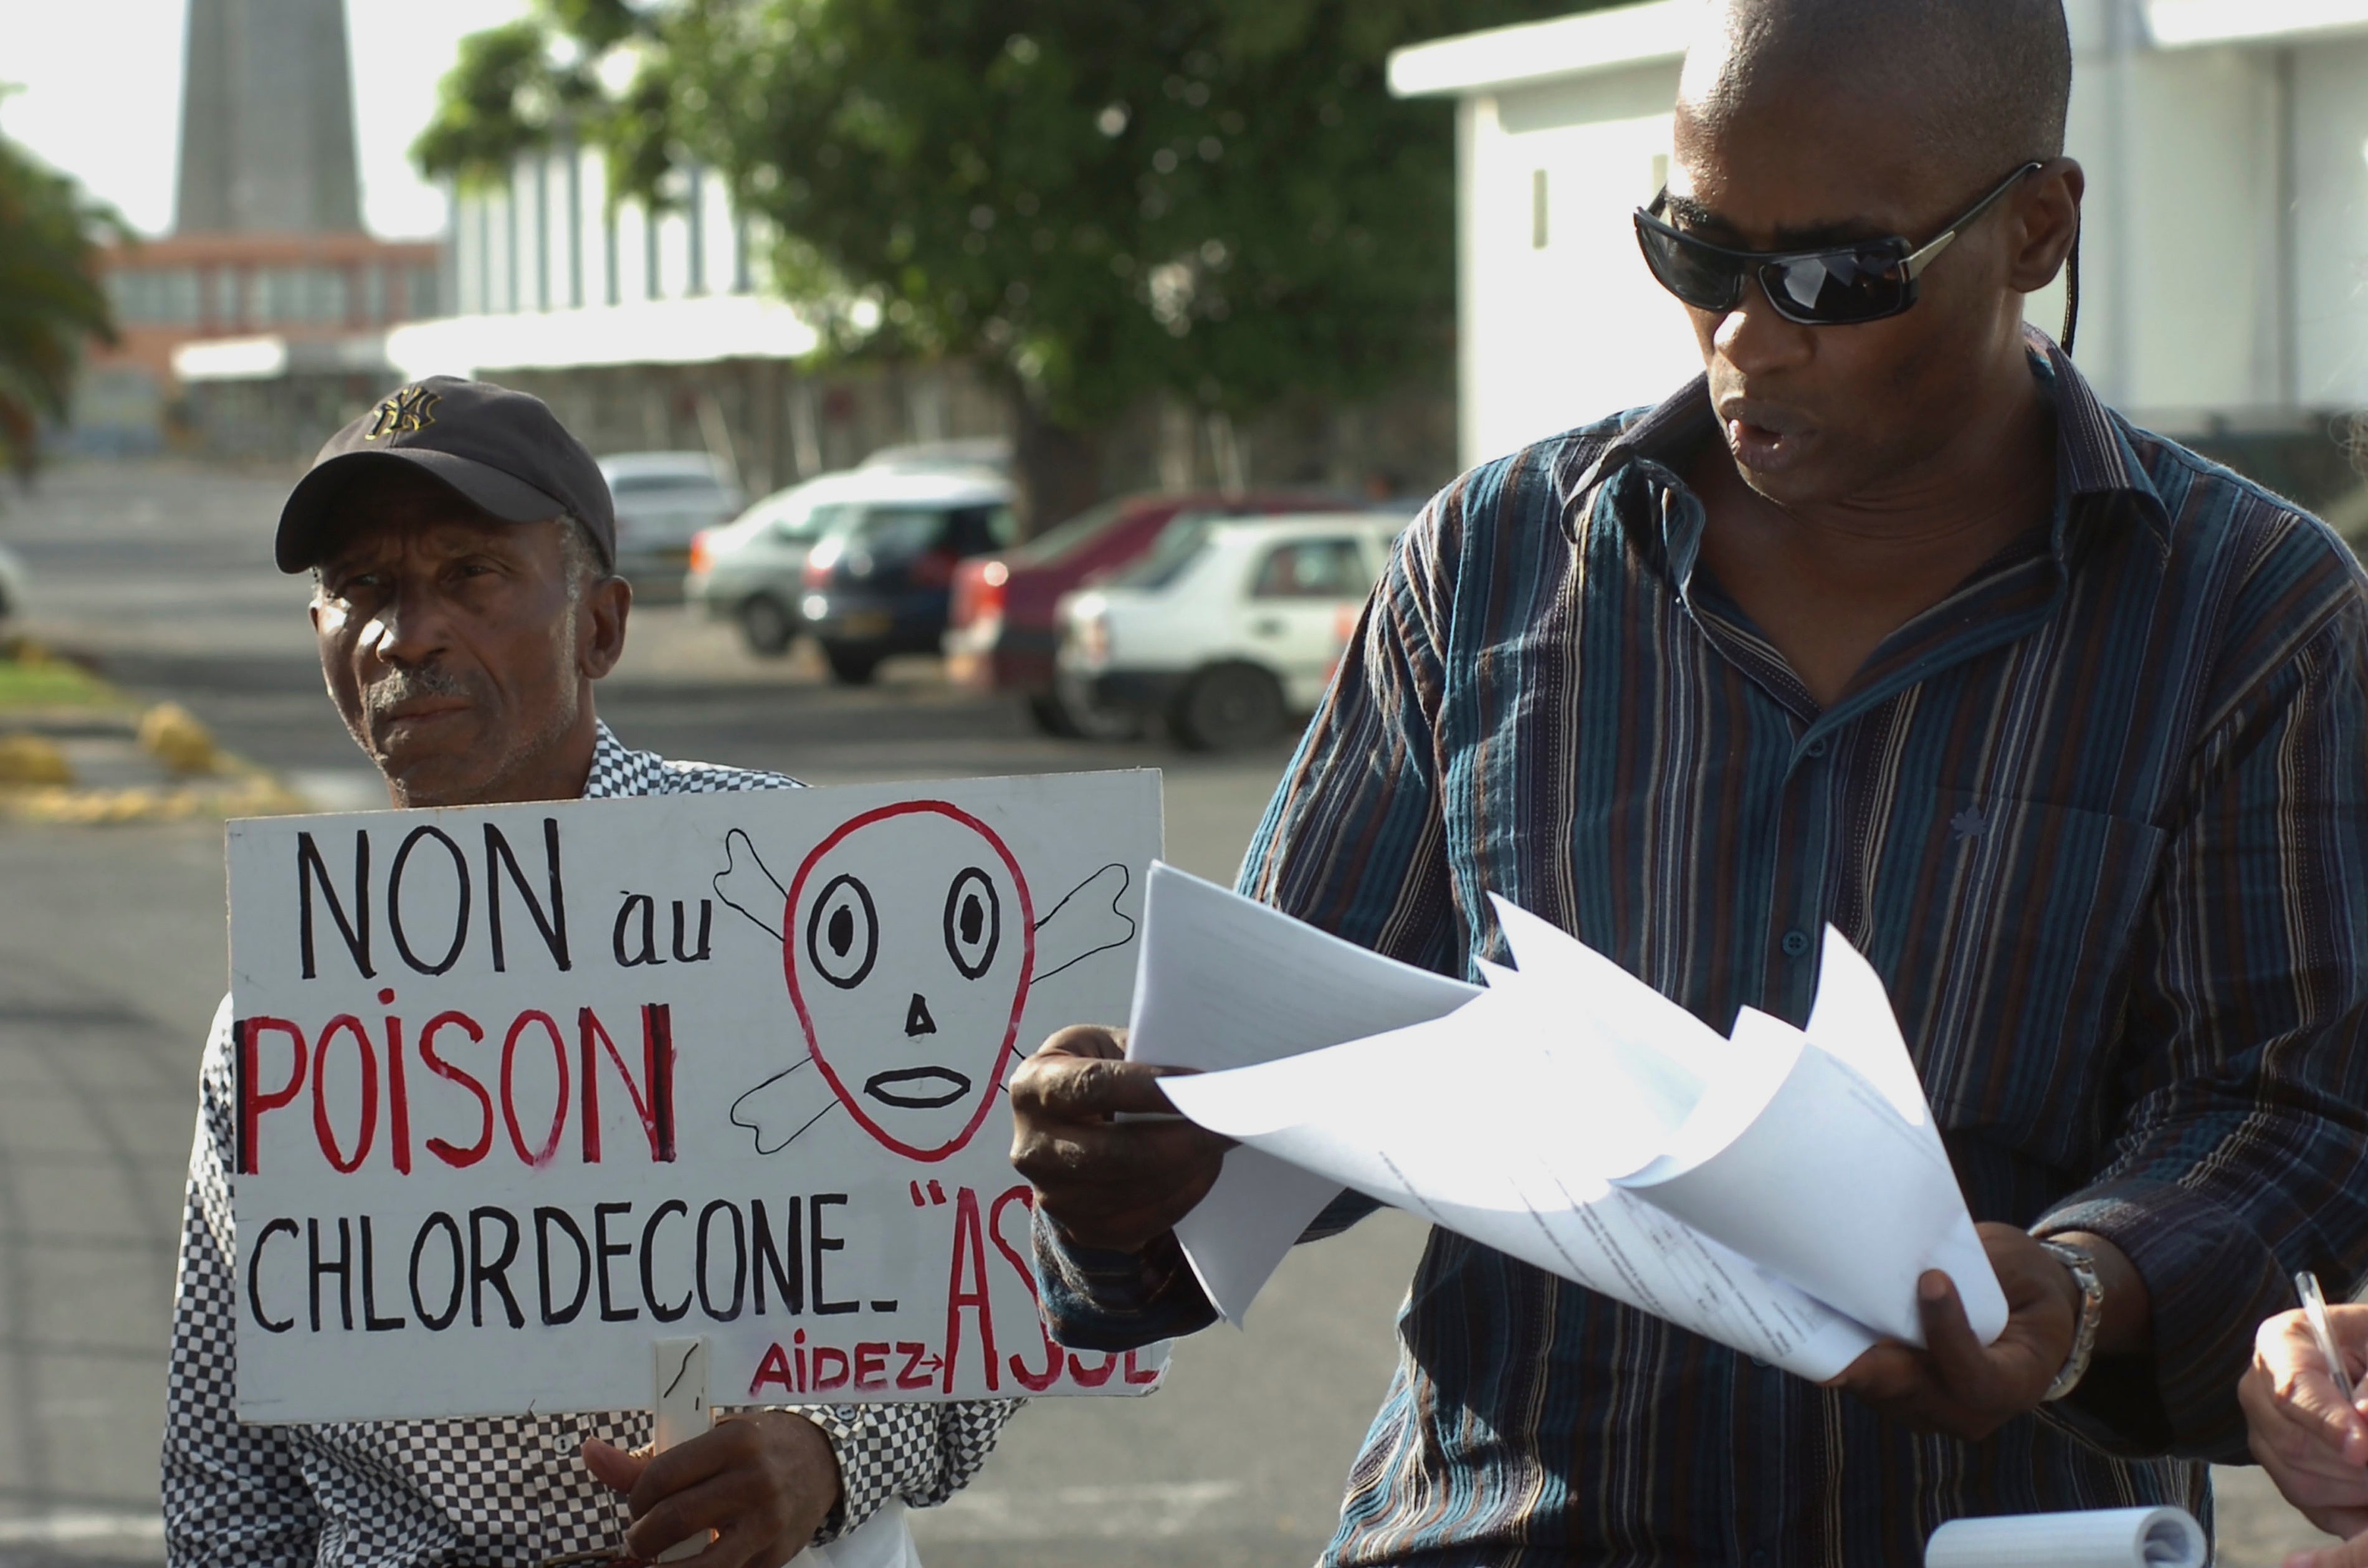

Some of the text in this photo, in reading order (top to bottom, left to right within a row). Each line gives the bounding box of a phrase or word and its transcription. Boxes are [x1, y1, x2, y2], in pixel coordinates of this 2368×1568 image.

[365, 385, 443, 440] NY
[297, 817, 712, 980] NON au
